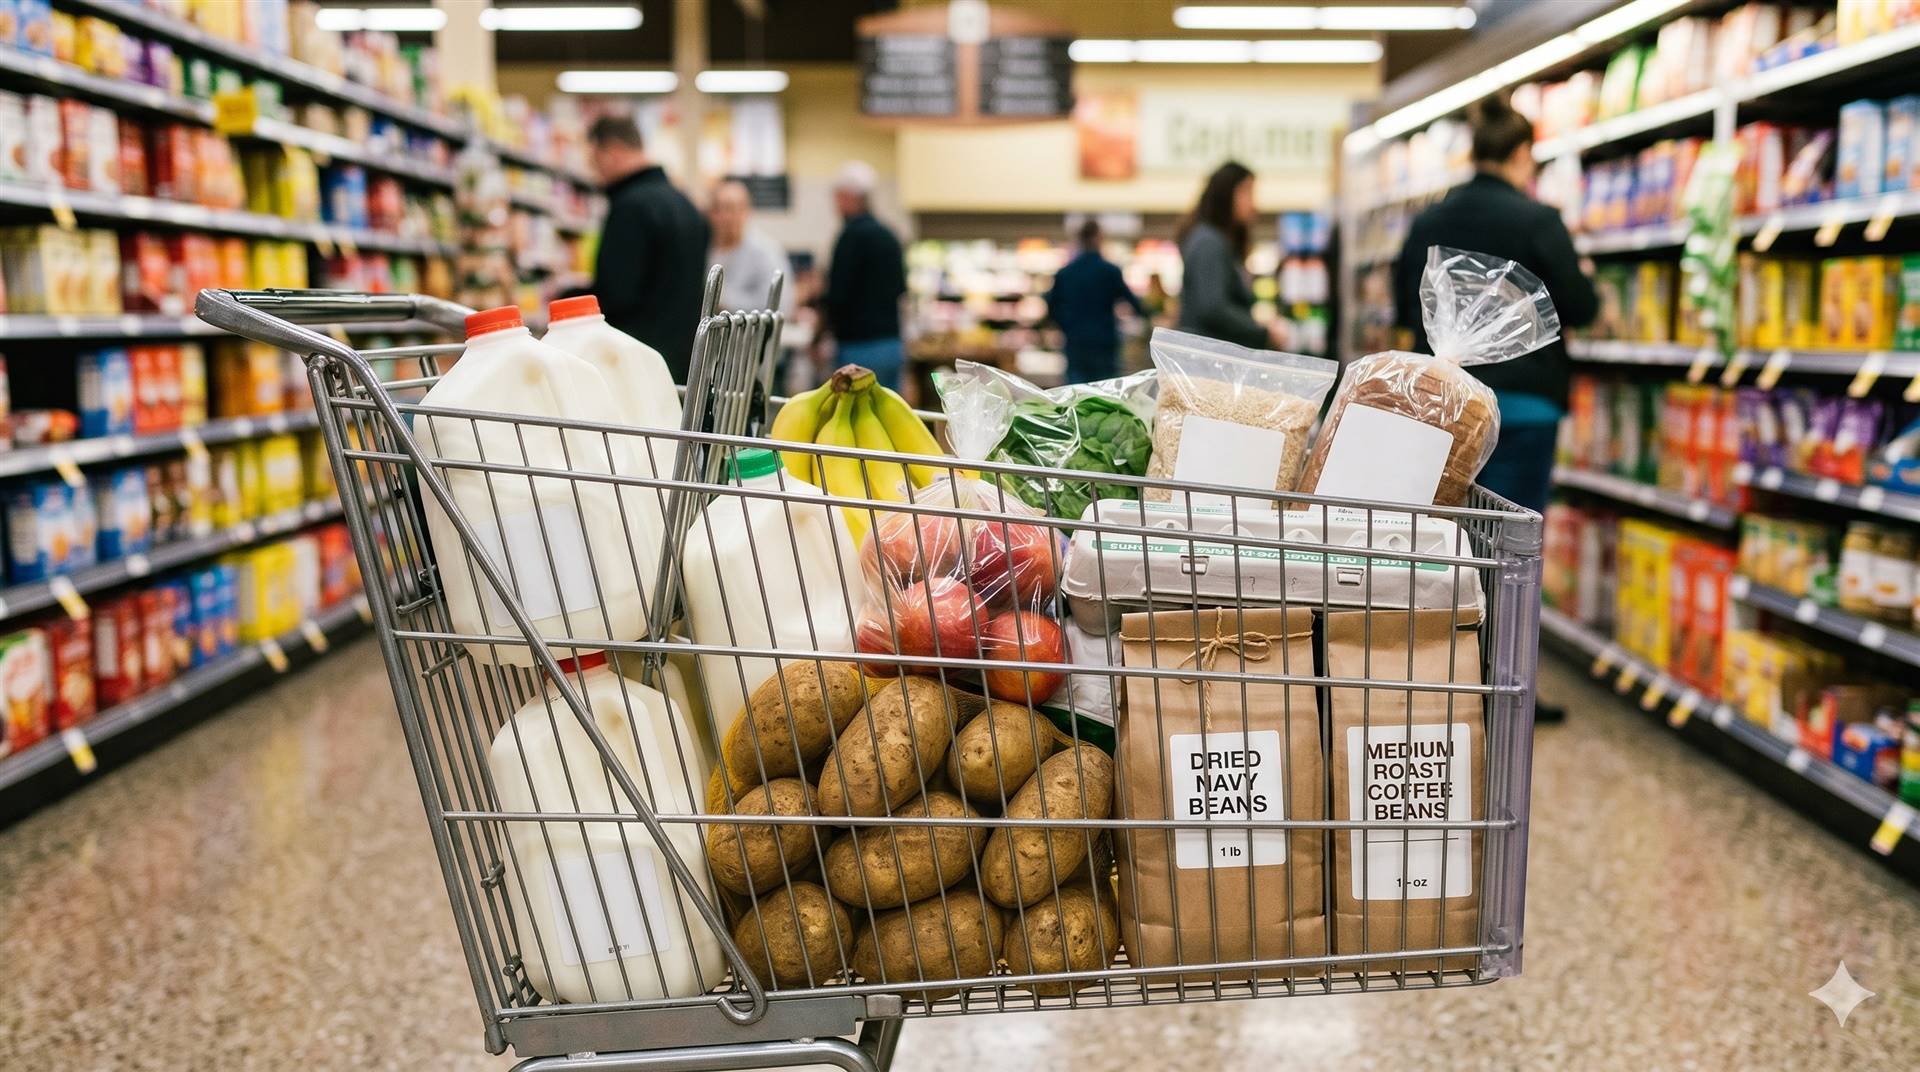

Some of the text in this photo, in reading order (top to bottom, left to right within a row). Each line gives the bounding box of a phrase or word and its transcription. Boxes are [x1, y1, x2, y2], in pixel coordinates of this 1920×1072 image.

[1367, 741, 1454, 760] MEDIUM
[1190, 750, 1261, 770] DRIED
[1374, 762, 1448, 780] ROAST
[1196, 773, 1258, 793] NAVY
[1368, 782, 1453, 800] COFFEE
[1189, 795, 1268, 815] BEANS
[1375, 802, 1448, 820] BEANS
[1220, 847, 1241, 857] 1 lb
